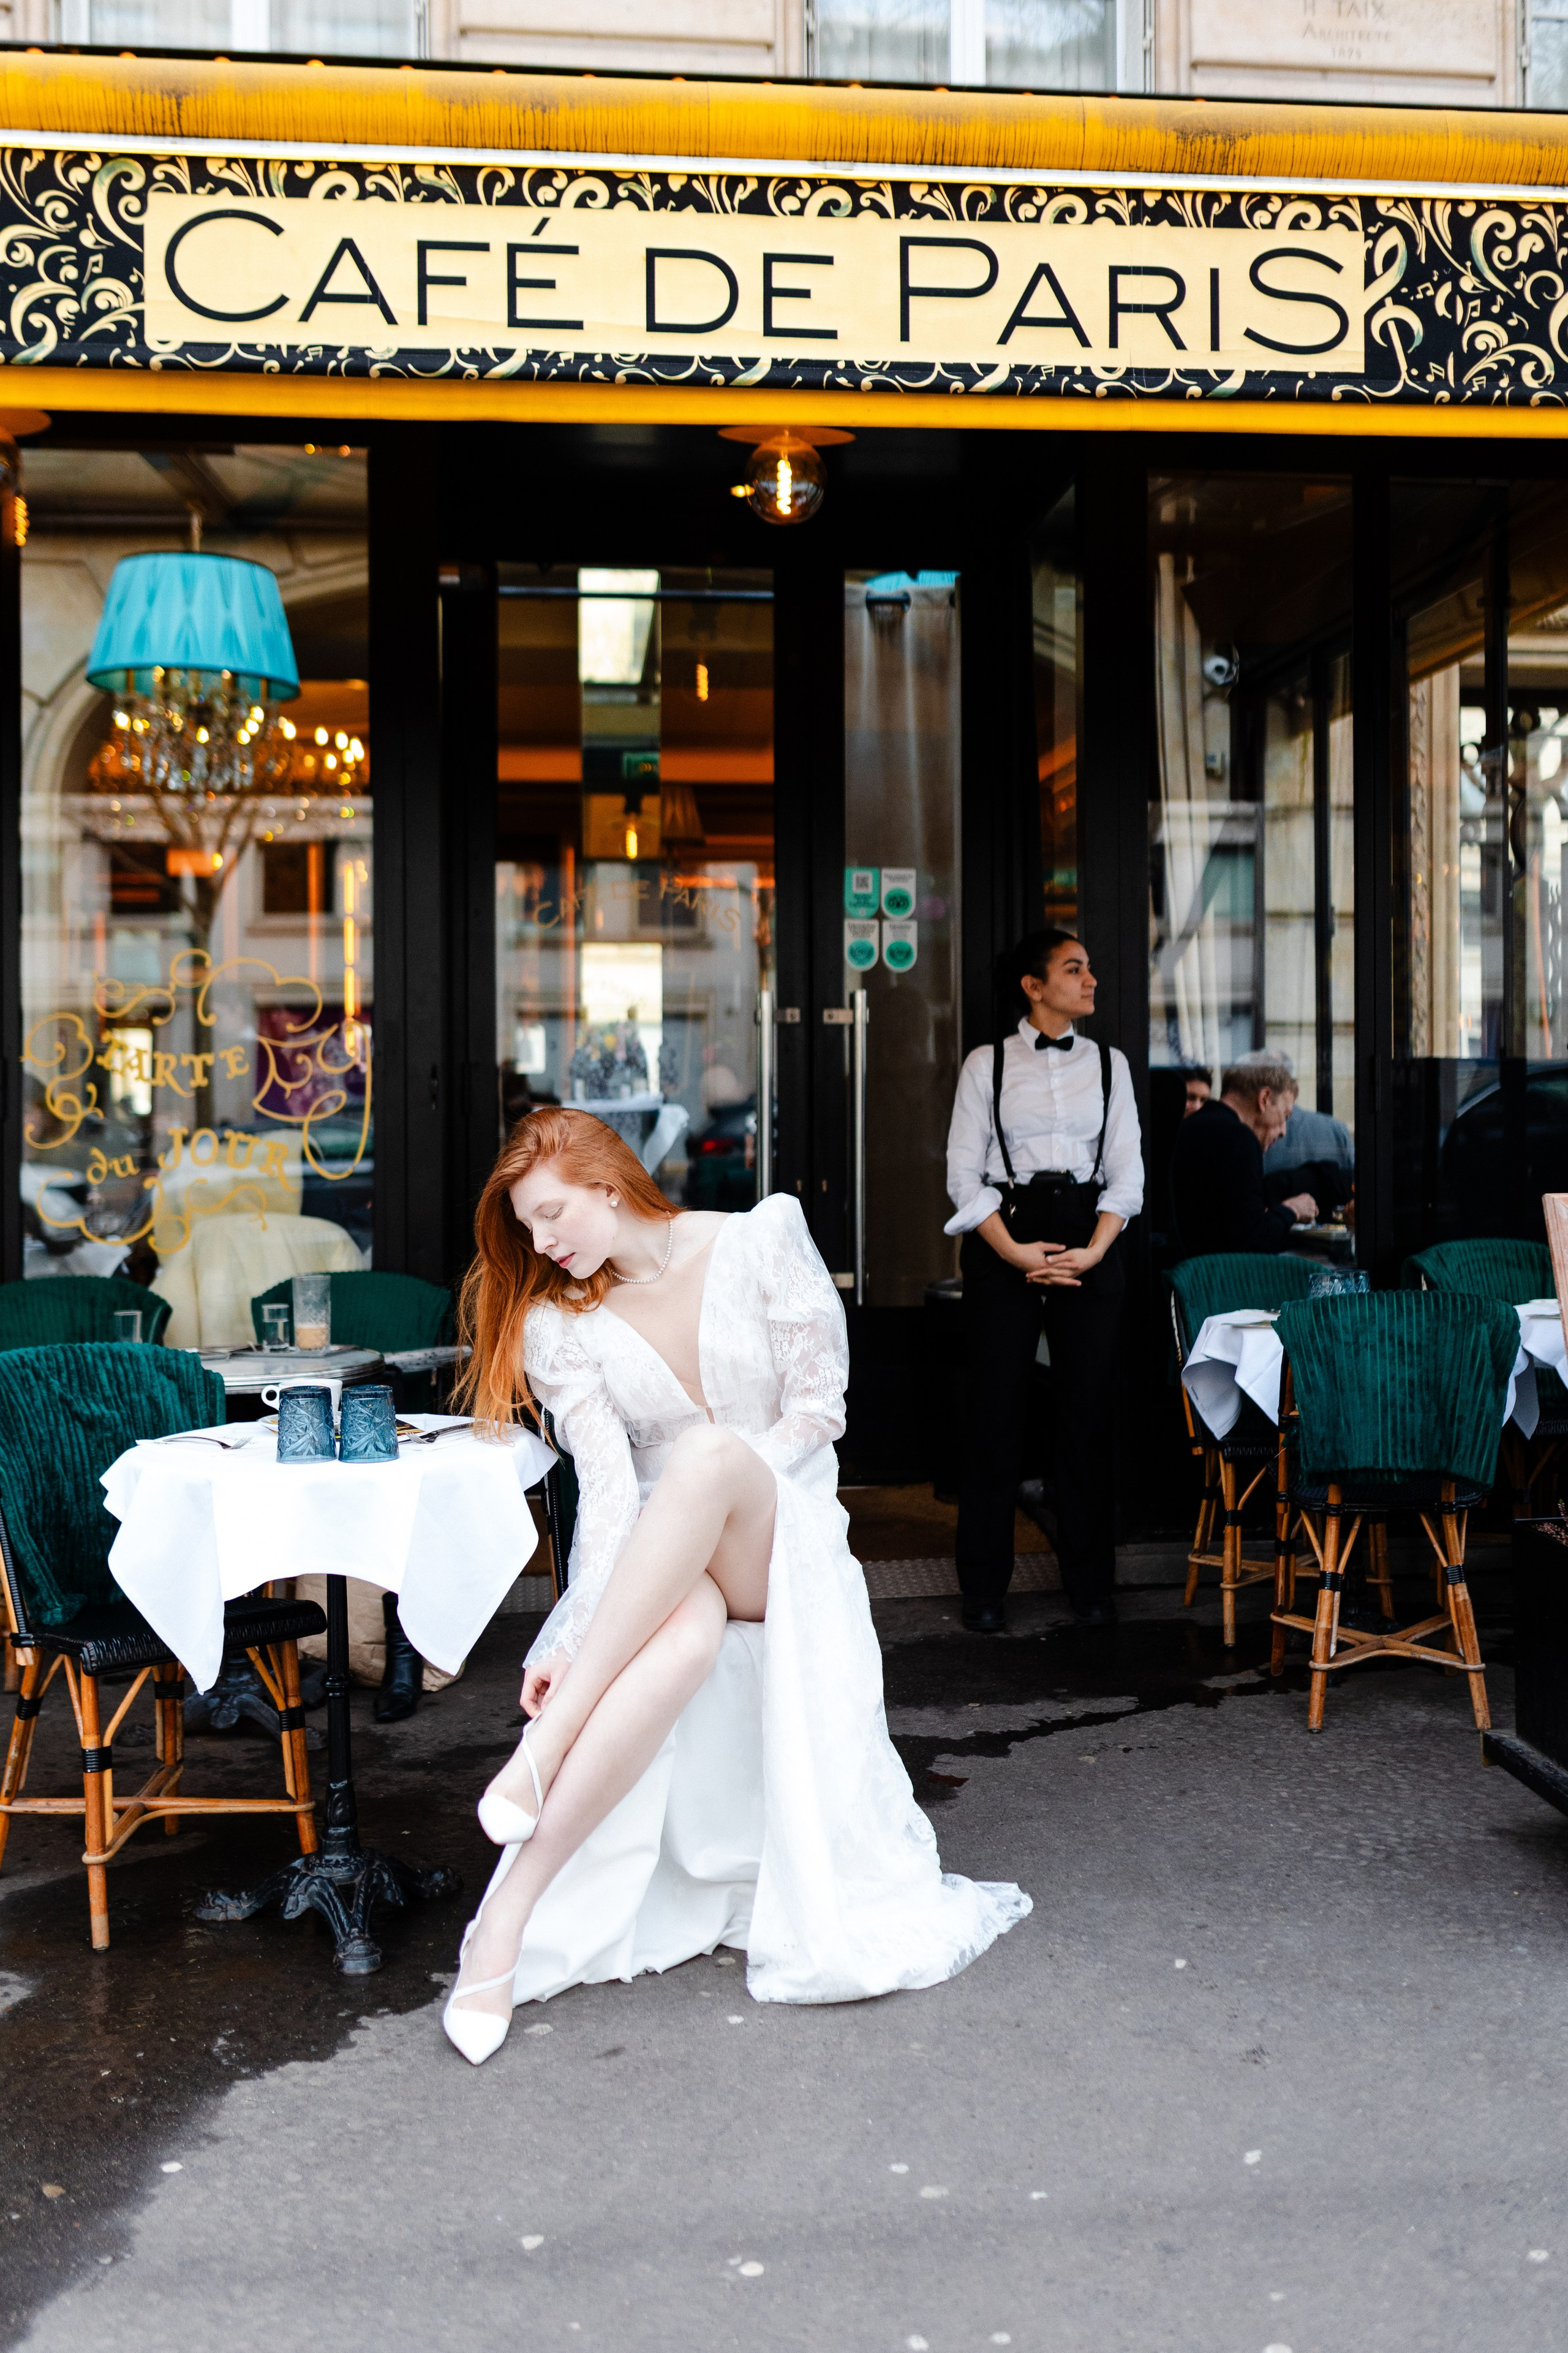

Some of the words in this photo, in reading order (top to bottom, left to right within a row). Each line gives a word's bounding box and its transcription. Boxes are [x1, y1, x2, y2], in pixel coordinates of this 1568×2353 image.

[164, 209, 584, 331] CAFÉ
[645, 247, 839, 339] DE
[899, 236, 1349, 355] PARIS
[157, 1127, 300, 1193] JOUR
